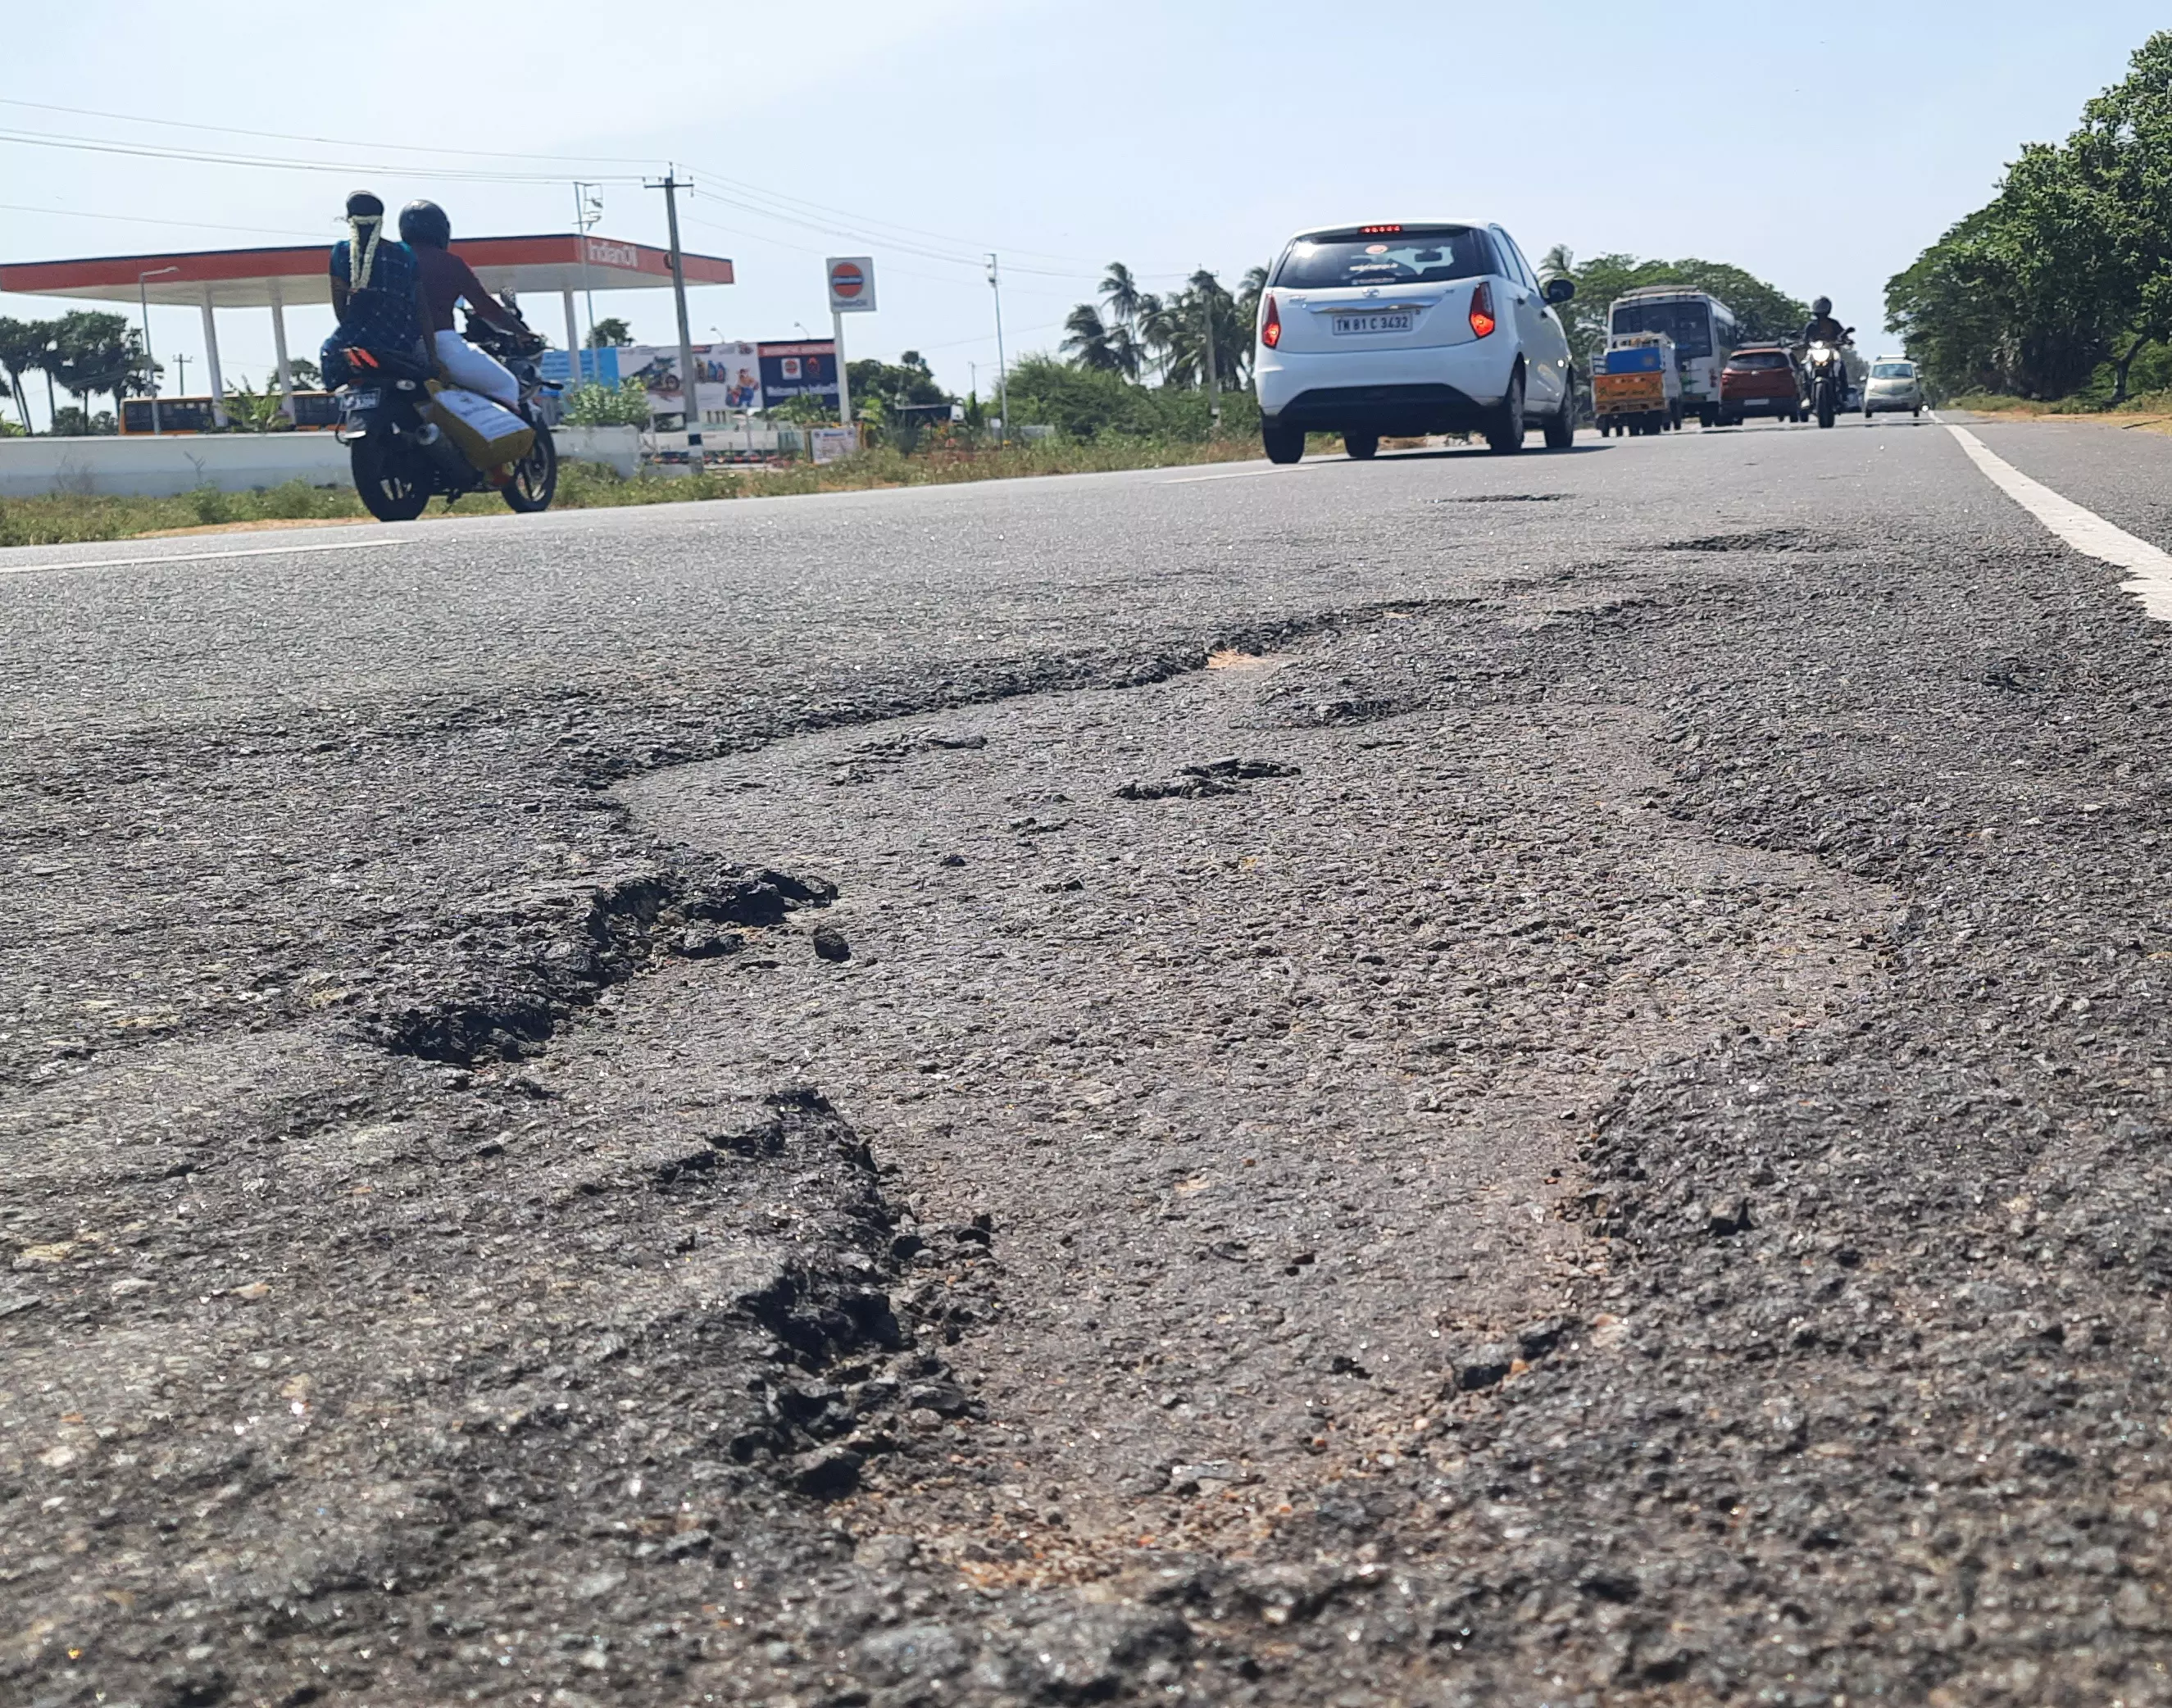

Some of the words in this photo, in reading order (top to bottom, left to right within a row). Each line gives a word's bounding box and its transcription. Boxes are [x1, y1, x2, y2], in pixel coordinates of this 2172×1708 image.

[1336, 319, 1350, 331] TN
[1370, 317, 1378, 329] C
[1380, 316, 1408, 329] 3432
